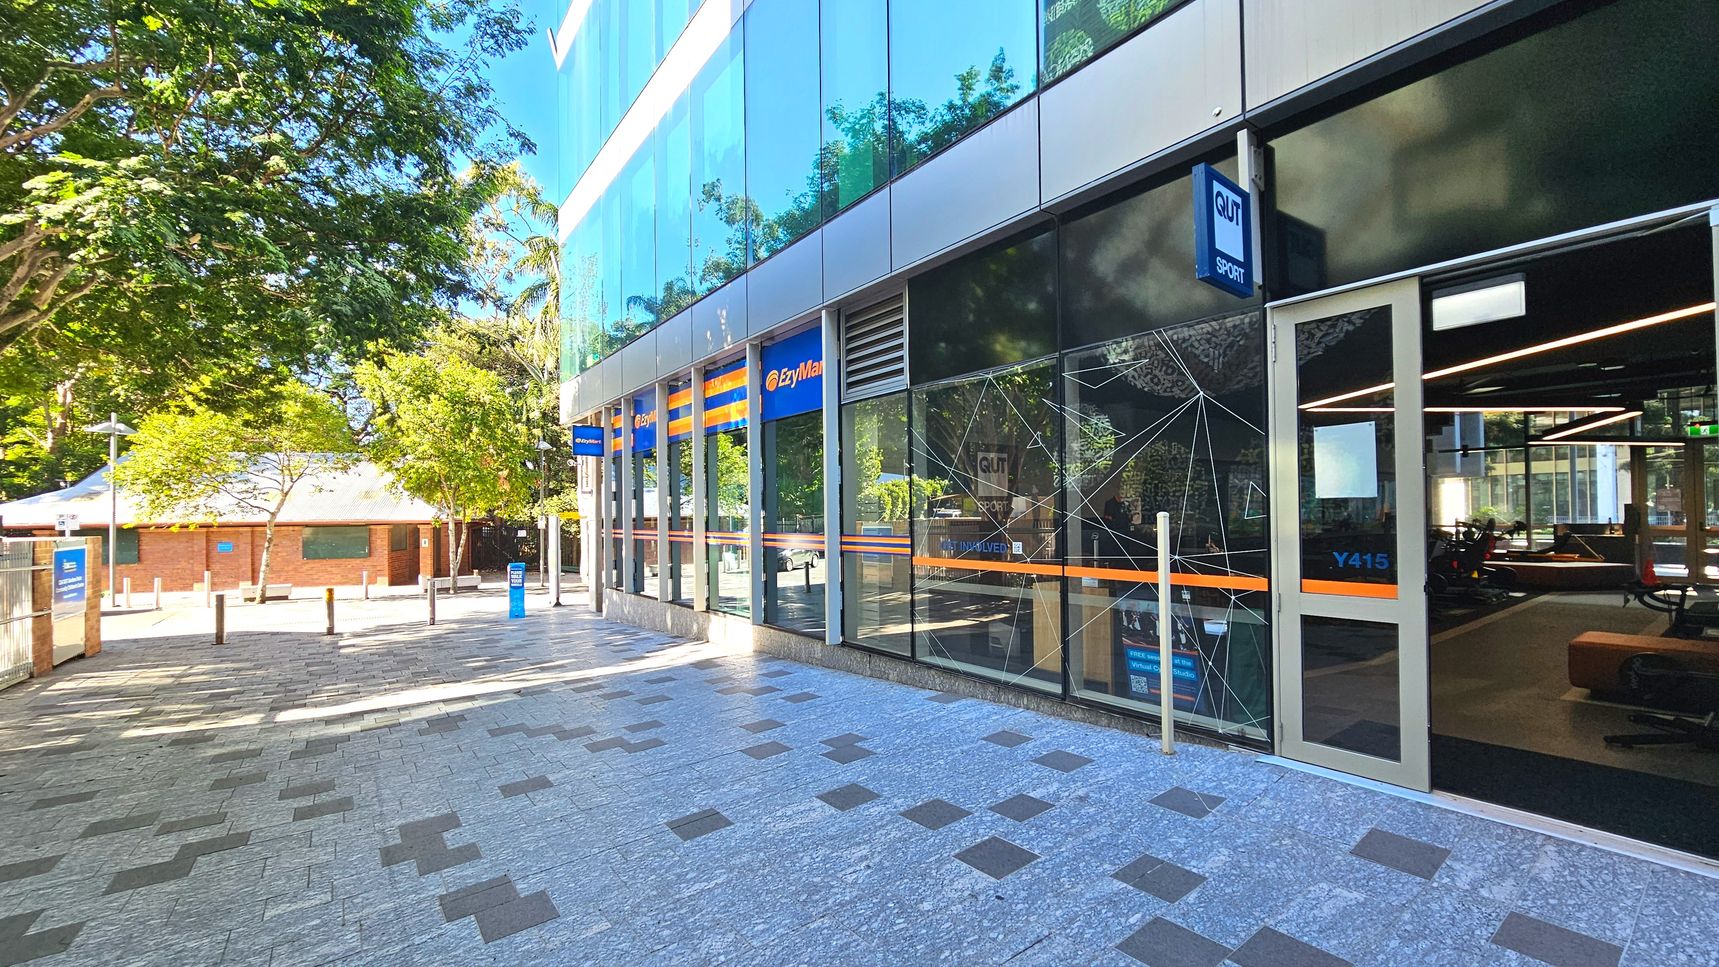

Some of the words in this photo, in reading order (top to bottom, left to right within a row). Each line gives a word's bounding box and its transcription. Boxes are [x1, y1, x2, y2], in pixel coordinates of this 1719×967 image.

[1215, 190, 1241, 226] QUT
[1216, 256, 1245, 284] SPORT
[778, 359, 824, 388] EzyMar
[979, 455, 1007, 474] QUT
[978, 500, 1008, 512] SPORT
[960, 541, 1008, 554] INVOLVED
[1333, 551, 1390, 569] Y415
[1130, 650, 1146, 659] FREE
[1131, 661, 1152, 670] Virtual
[1173, 669, 1195, 679] Studio
